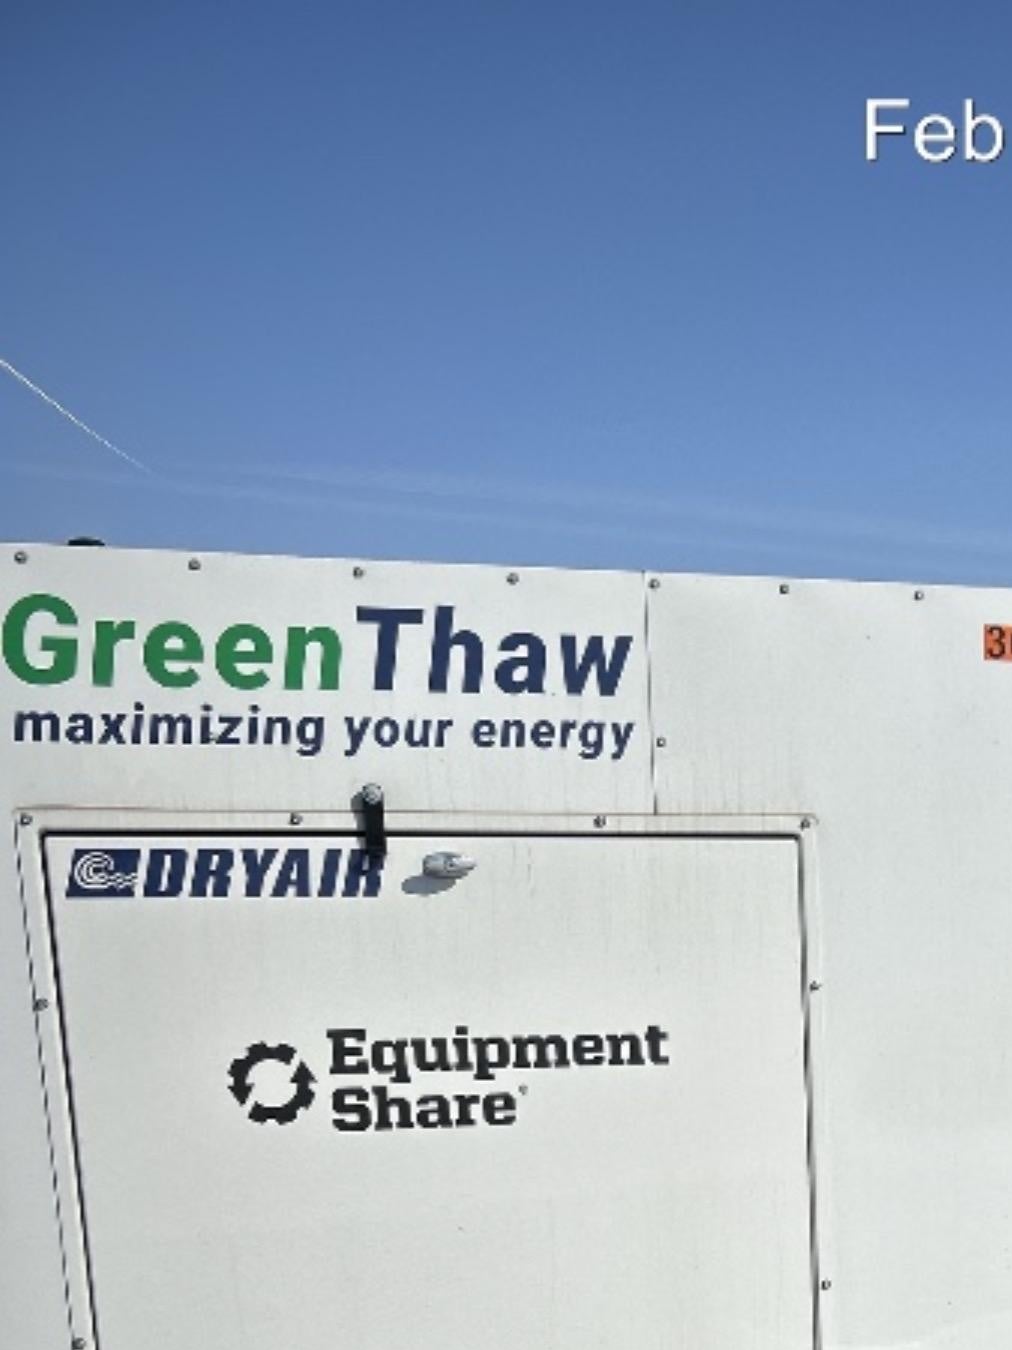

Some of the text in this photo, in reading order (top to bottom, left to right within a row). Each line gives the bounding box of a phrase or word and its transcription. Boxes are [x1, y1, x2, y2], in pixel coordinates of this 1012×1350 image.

[13, 701, 635, 760] maximizing your energy
[142, 847, 387, 898] DRYAIR
[326, 1025, 670, 1083] Equipment
